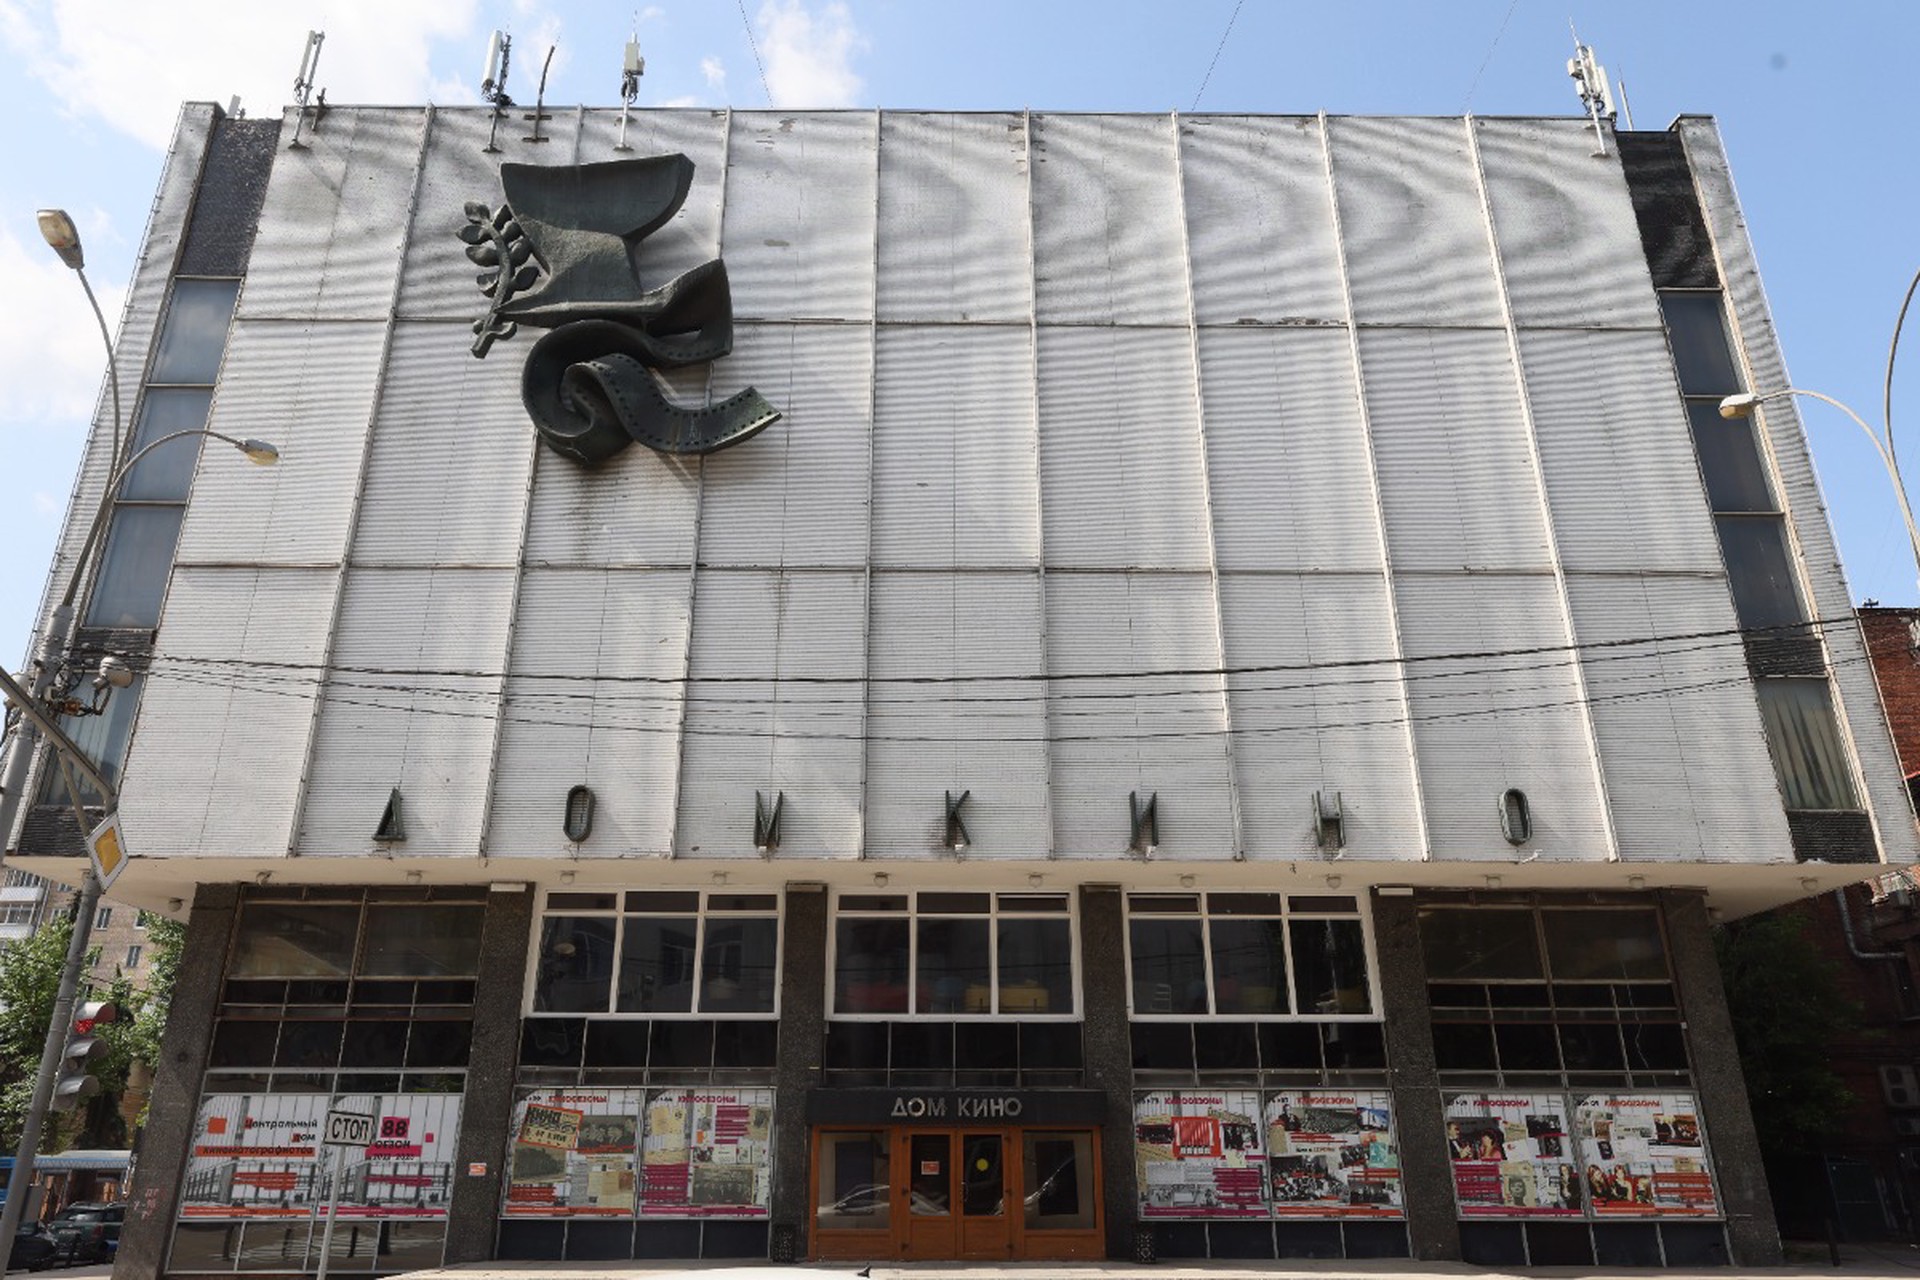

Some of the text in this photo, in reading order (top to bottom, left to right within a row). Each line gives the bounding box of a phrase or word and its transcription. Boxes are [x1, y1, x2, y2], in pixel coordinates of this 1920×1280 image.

[891, 1097, 1022, 1117] ДОМ КИНО
[332, 1117, 369, 1140] СТОП
[382, 1120, 408, 1137] 88
